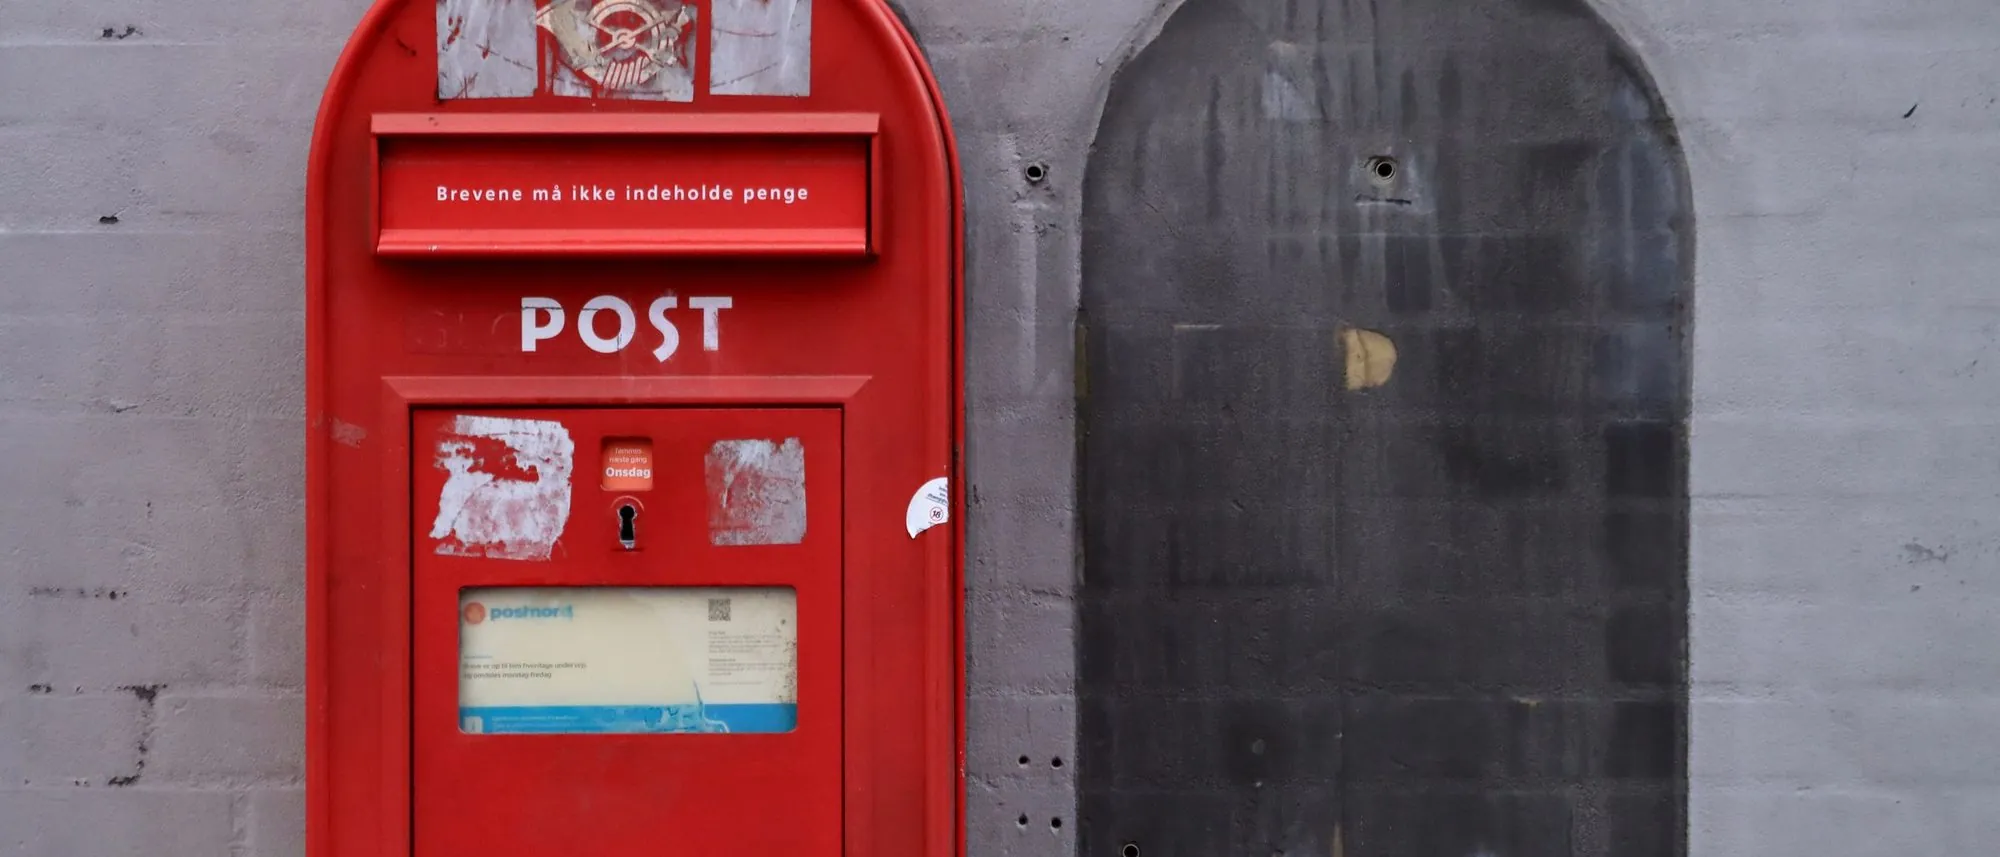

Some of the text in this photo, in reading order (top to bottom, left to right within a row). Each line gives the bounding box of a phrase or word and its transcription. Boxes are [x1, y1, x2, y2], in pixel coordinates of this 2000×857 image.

[437, 184, 808, 204] Brevene må ikke indeholde penge
[521, 294, 733, 363] POST
[605, 467, 651, 479] Onsdag
